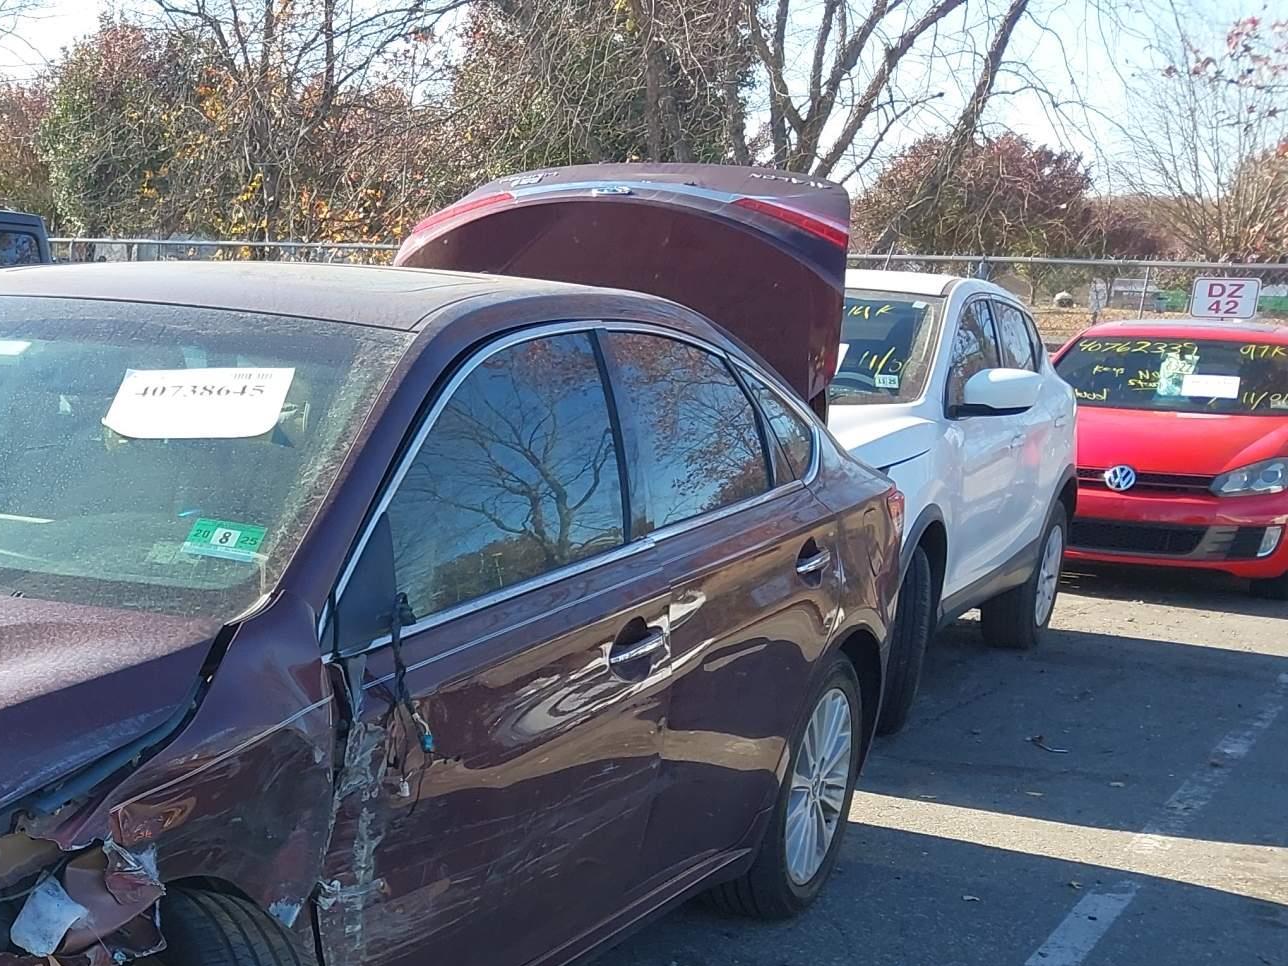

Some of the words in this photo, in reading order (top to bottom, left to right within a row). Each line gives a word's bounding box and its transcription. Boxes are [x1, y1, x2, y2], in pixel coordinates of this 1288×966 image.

[1207, 282, 1246, 299] DZ
[1207, 299, 1240, 315] 42
[1078, 339, 1199, 357] 40762339
[135, 385, 266, 398] 40738645
[193, 528, 211, 539] 20
[218, 530, 233, 545] 8
[240, 536, 258, 546] 25
